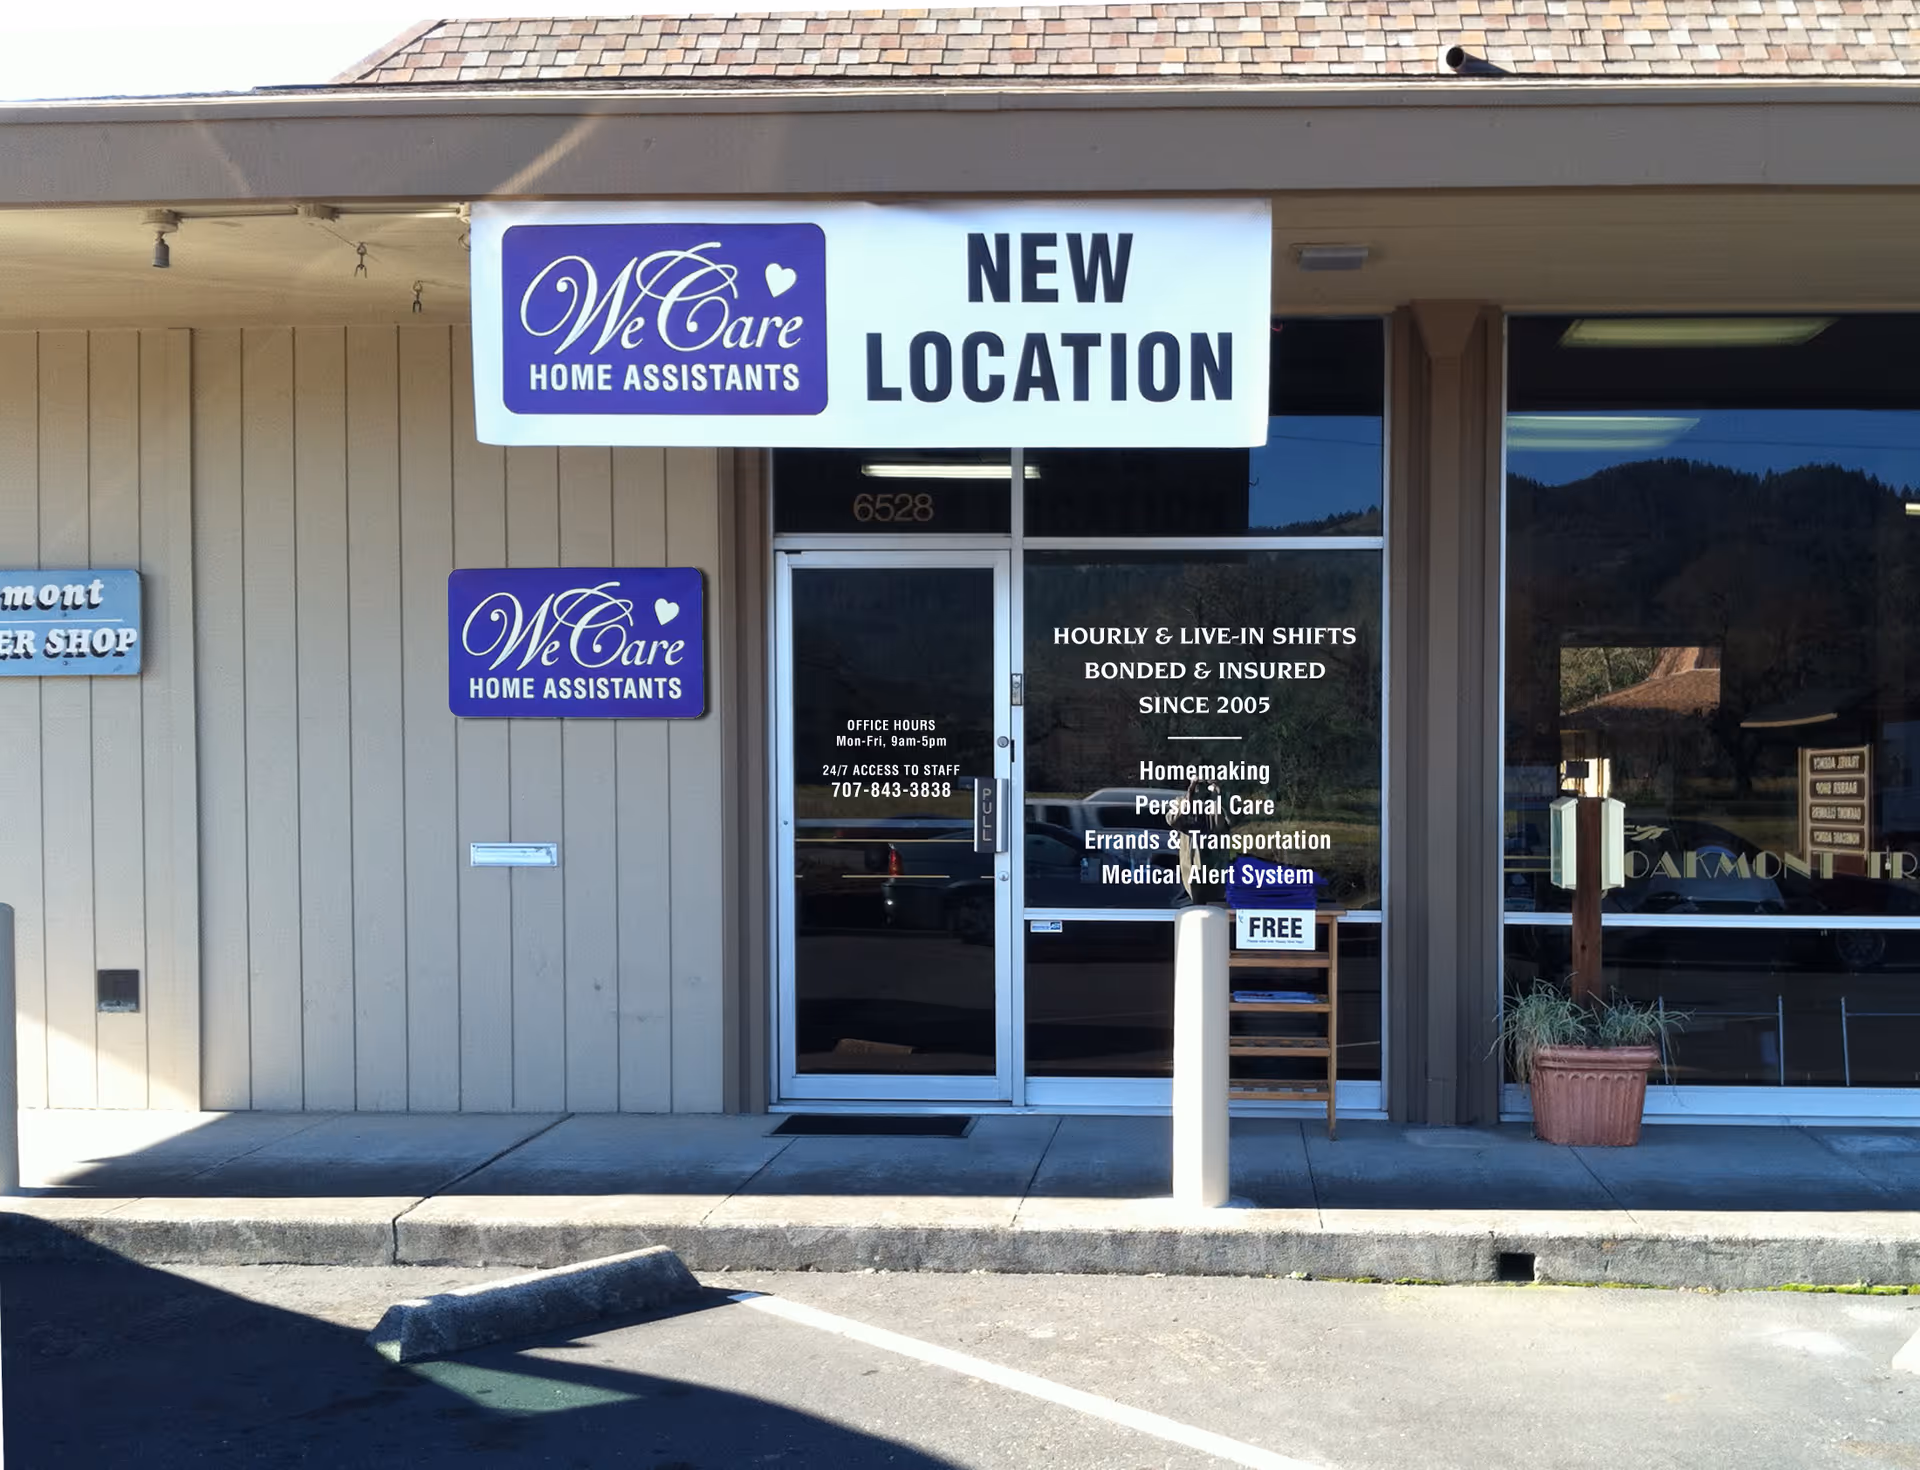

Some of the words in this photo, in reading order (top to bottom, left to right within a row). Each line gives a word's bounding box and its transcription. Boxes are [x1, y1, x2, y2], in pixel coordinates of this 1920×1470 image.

[967, 233, 1134, 303] NEW
[520, 255, 645, 355] We
[636, 242, 803, 352] Care
[530, 364, 612, 391] HOME
[623, 364, 800, 391] ASSISTANTS
[866, 331, 1233, 403] LOCATION
[853, 493, 934, 521] 6528
[462, 592, 561, 671] We
[553, 581, 685, 668] Care
[1054, 627, 1149, 645] HOURLY
[1155, 627, 1173, 645] &
[1180, 627, 1264, 645] LIVE-IN
[1272, 627, 1357, 645] SHIFTS
[43, 627, 138, 659] SHOP
[1085, 662, 1186, 680] BONDED
[1193, 662, 1212, 680] &
[1219, 662, 1326, 680] INSURED
[469, 677, 535, 699] HOME
[543, 677, 682, 699] ASSISTANTS
[1139, 696, 1210, 714] SINCE
[1217, 696, 1271, 714] 2005
[847, 719, 889, 731] OFFICE
[893, 719, 936, 731] HOURS
[836, 735, 886, 748] Mon-Fri,
[891, 735, 947, 749] 9am-5pm
[822, 764, 848, 777] 24/7
[852, 764, 899, 776] ACCESS
[903, 764, 919, 776] TO
[923, 764, 960, 776] STAFF
[1139, 760, 1271, 785] Homemaking
[831, 782, 951, 798] 707-843-3838
[982, 788, 993, 842] PULL
[1135, 794, 1222, 815] Personal
[1229, 794, 1275, 815] Care
[1085, 829, 1160, 850] Errands
[1168, 830, 1182, 850] &
[1188, 829, 1331, 854] Transportation
[1102, 864, 1182, 885] Medical
[1187, 864, 1236, 885] Alert
[1241, 864, 1315, 889] System
[1624, 851, 1839, 879] OAKMONT
[1249, 917, 1303, 938] FREE
